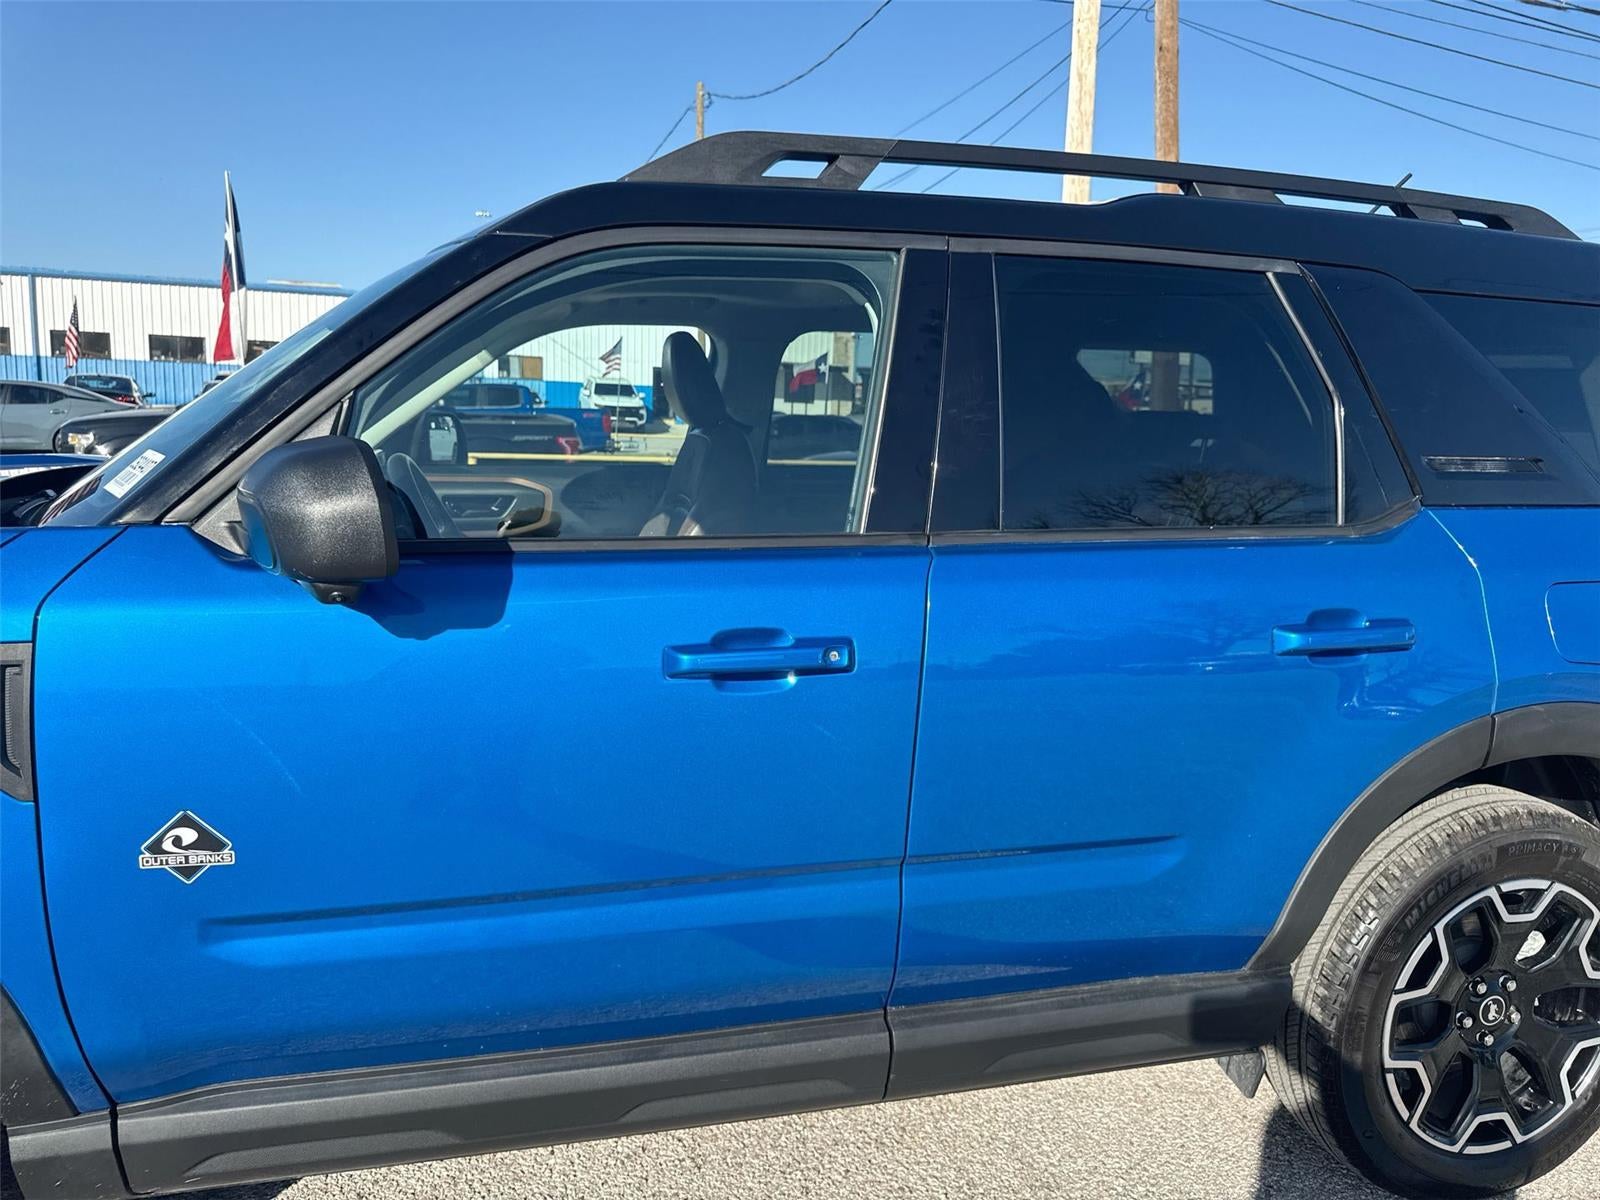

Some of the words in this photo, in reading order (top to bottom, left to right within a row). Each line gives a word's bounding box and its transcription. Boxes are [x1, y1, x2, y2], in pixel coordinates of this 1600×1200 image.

[1508, 842, 1560, 857] PRIMACY
[143, 855, 186, 866] OUTER
[188, 853, 232, 864] BANKS
